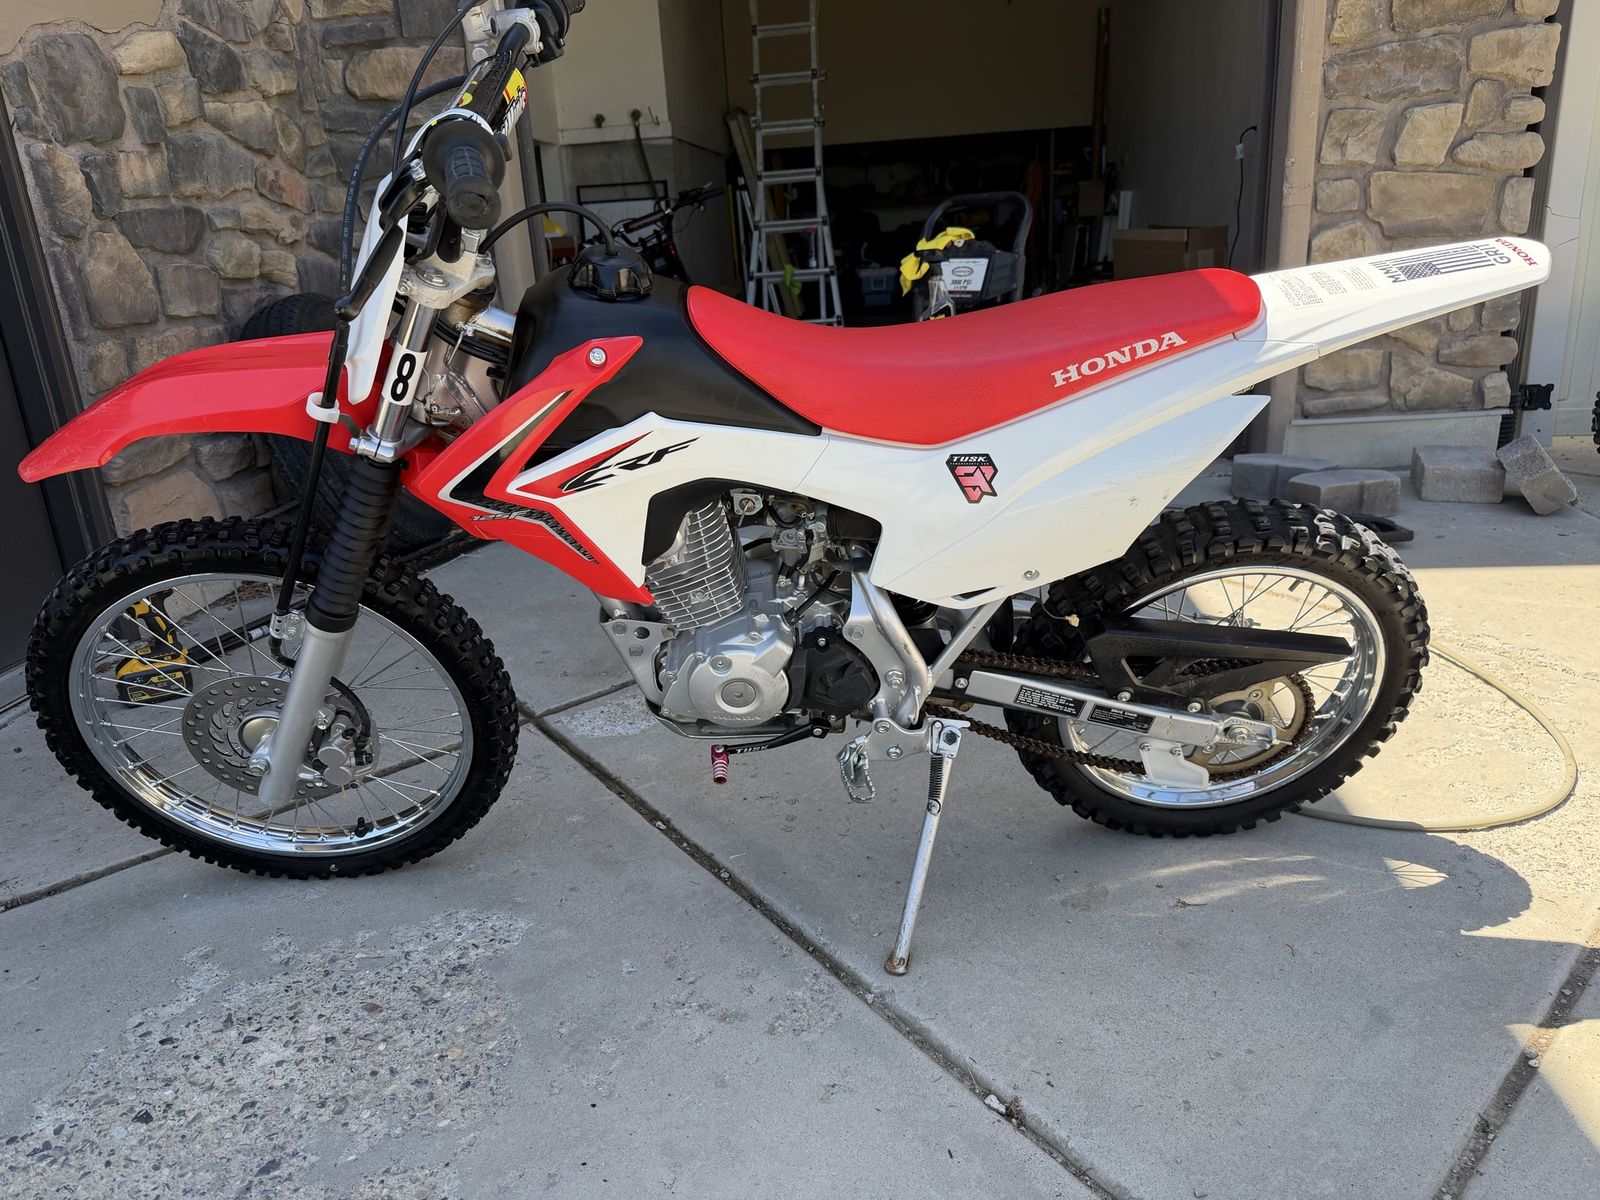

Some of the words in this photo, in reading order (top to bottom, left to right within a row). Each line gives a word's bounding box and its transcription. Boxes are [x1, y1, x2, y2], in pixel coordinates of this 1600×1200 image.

[1472, 243, 1511, 264] GRIT
[1494, 238, 1538, 266] HONDA
[390, 353, 417, 402] 8
[1051, 331, 1187, 388] HONDA
[558, 435, 701, 492] CRF
[736, 745, 769, 754] TUSK
